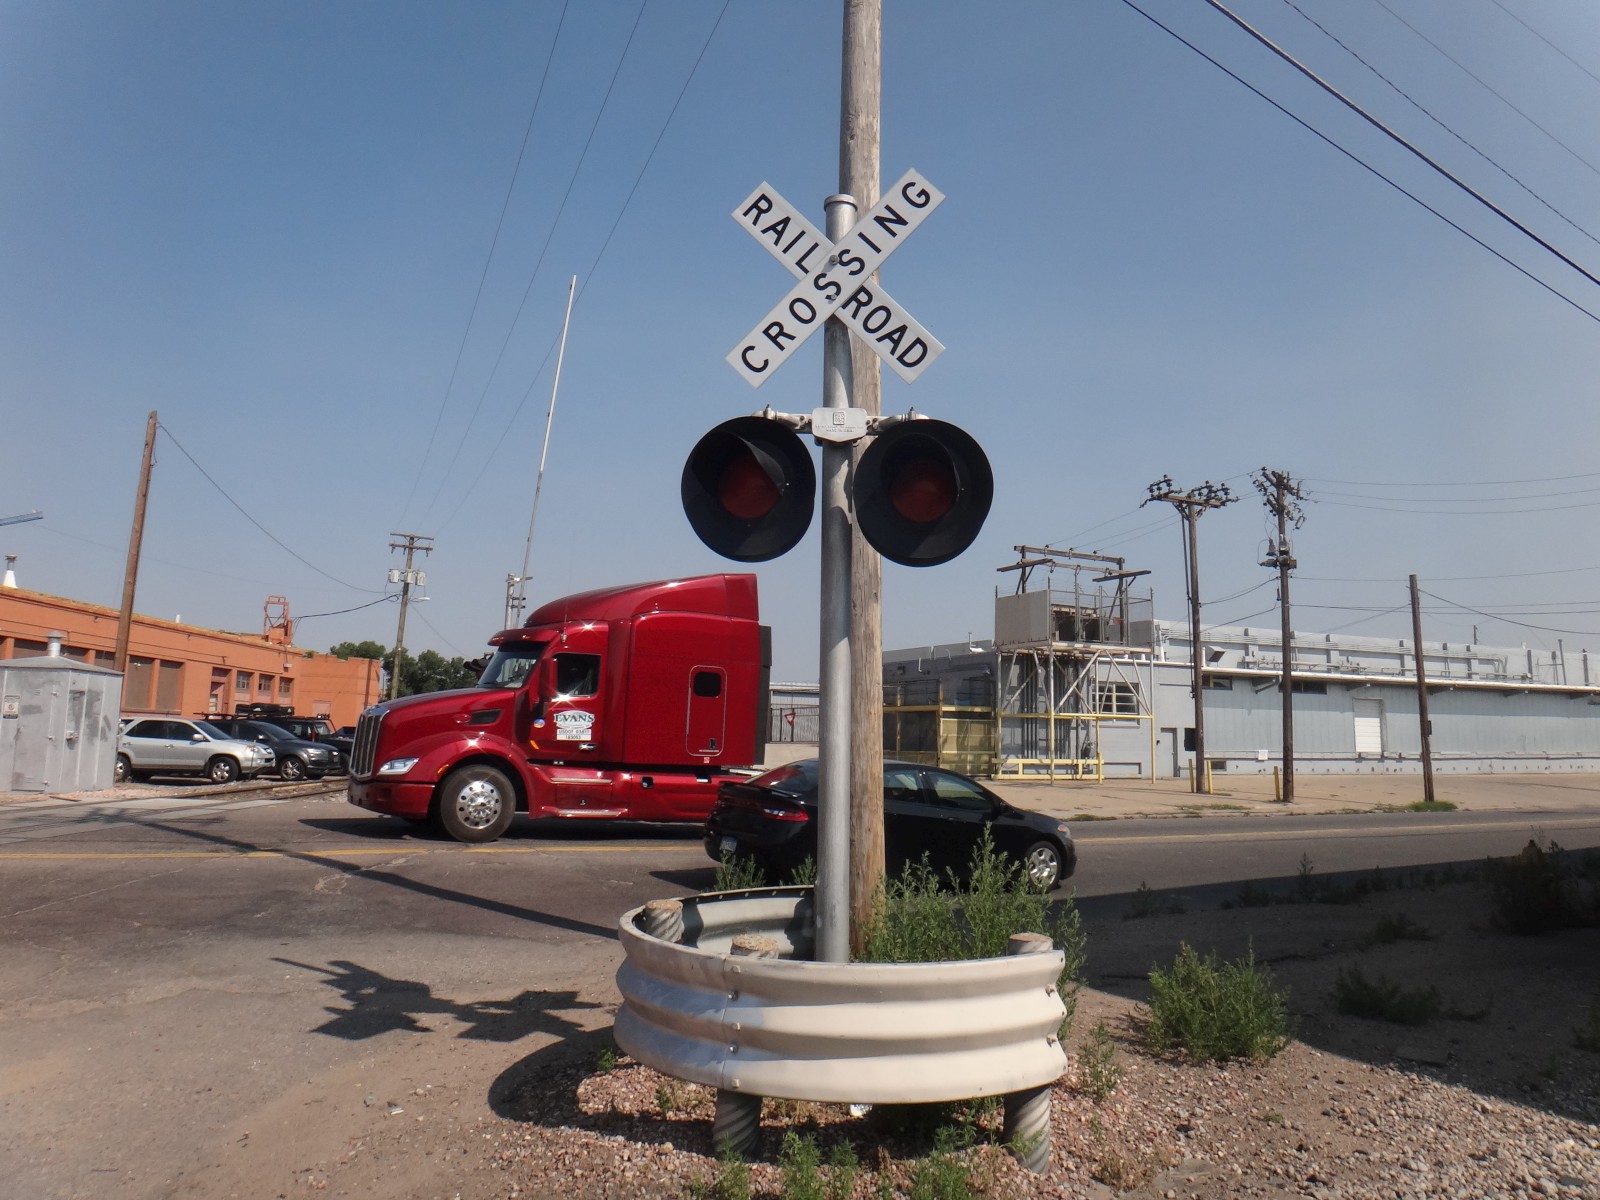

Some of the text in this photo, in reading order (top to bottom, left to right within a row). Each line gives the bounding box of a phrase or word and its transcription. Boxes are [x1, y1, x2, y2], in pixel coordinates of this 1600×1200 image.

[741, 181, 931, 373] CROSSING
[742, 193, 928, 368] RAIL ROAD
[555, 714, 594, 722] EVANS
